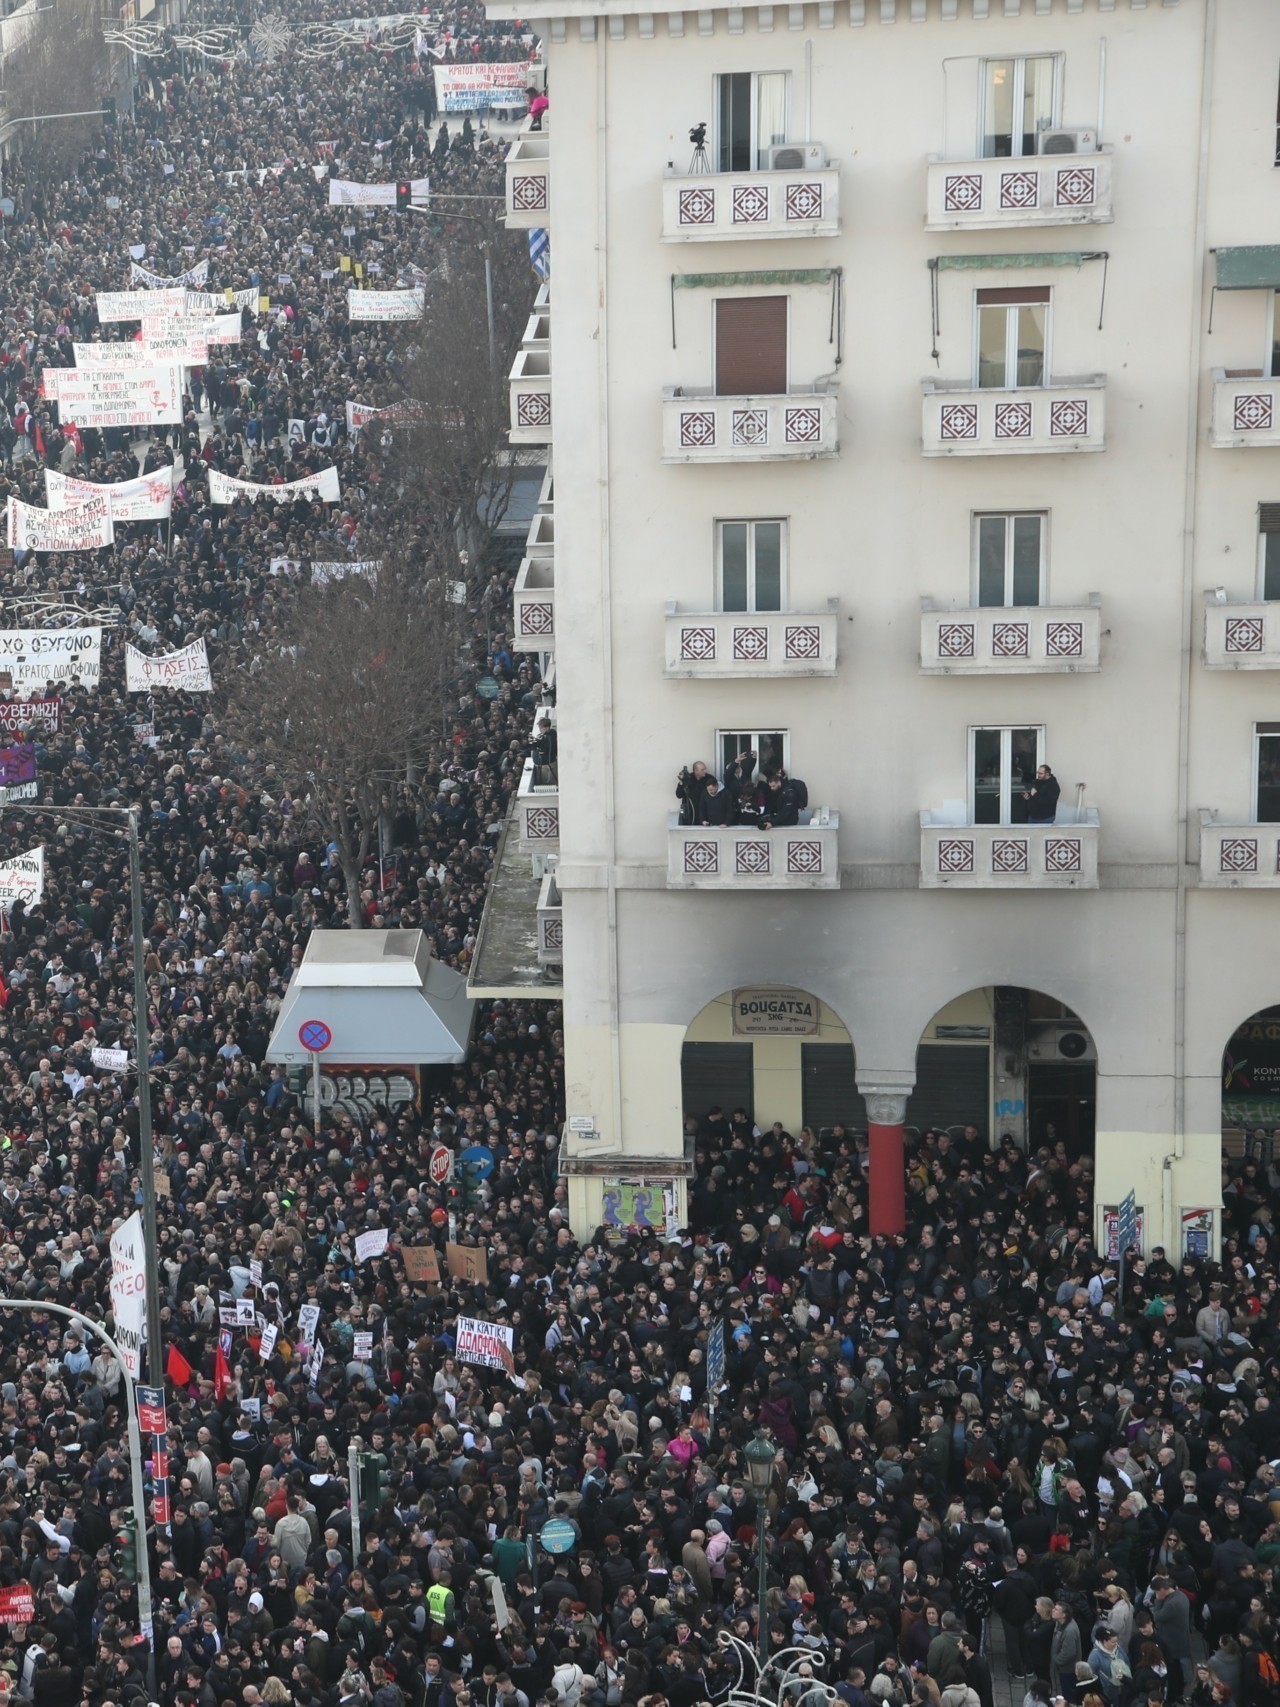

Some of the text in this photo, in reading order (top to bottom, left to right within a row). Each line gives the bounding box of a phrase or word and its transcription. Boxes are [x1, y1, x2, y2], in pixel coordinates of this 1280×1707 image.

[83, 496, 104, 512] ΜΕΧΡΙ
[20, 664, 51, 680] ΚΡΑΤΟΣ
[740, 1001, 812, 1016] BOUGATSA
[432, 1152, 449, 1177] STOP
[458, 1318, 506, 1340] ΤΗΝ ΚΡΑΤΙΚΗ
